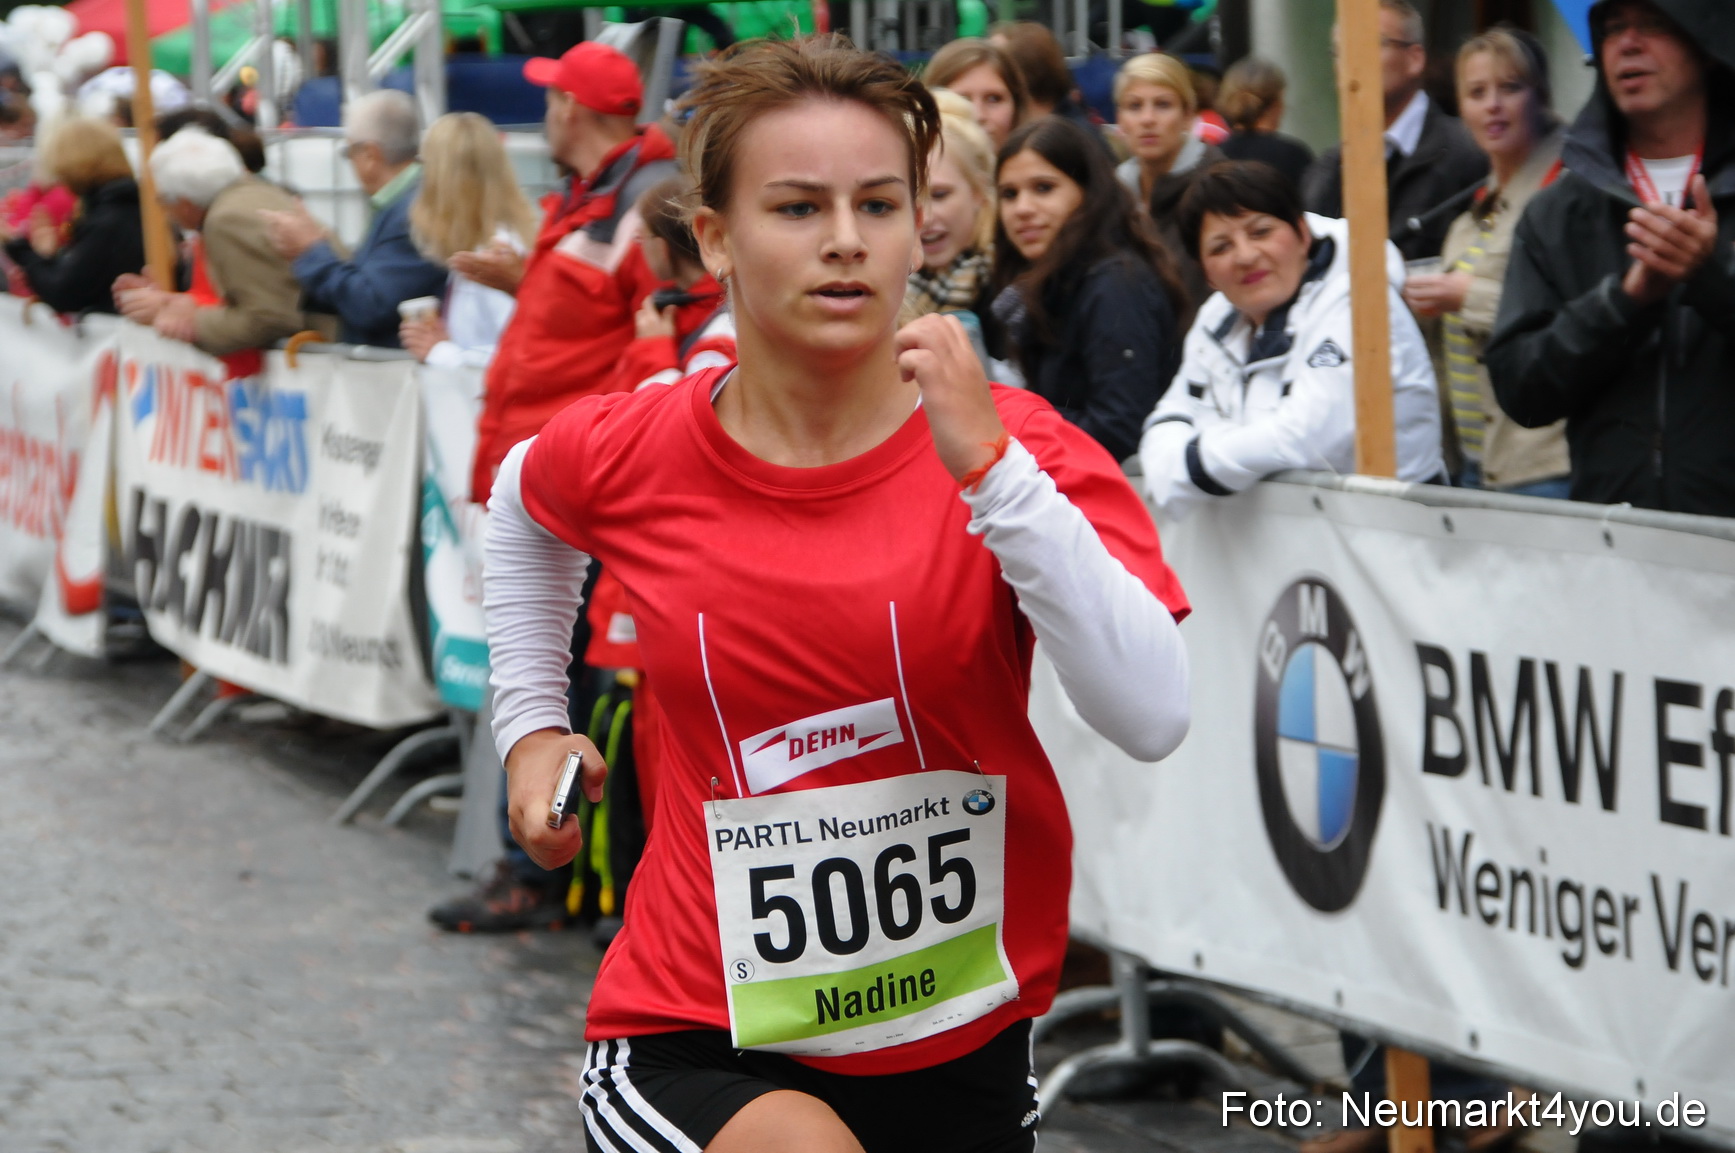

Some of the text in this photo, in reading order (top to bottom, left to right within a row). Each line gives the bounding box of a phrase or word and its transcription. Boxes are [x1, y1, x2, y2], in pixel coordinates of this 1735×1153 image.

[1261, 583, 1371, 700] BMW
[788, 723, 856, 762] DEHN
[1414, 641, 1735, 836] BMW Ef
[715, 820, 813, 852] PARTL
[818, 796, 952, 842] Neumarkt
[748, 827, 977, 965] 5065
[1425, 821, 1735, 987] Weniger Ver
[737, 962, 748, 979] S
[814, 968, 936, 1025] Nadine
